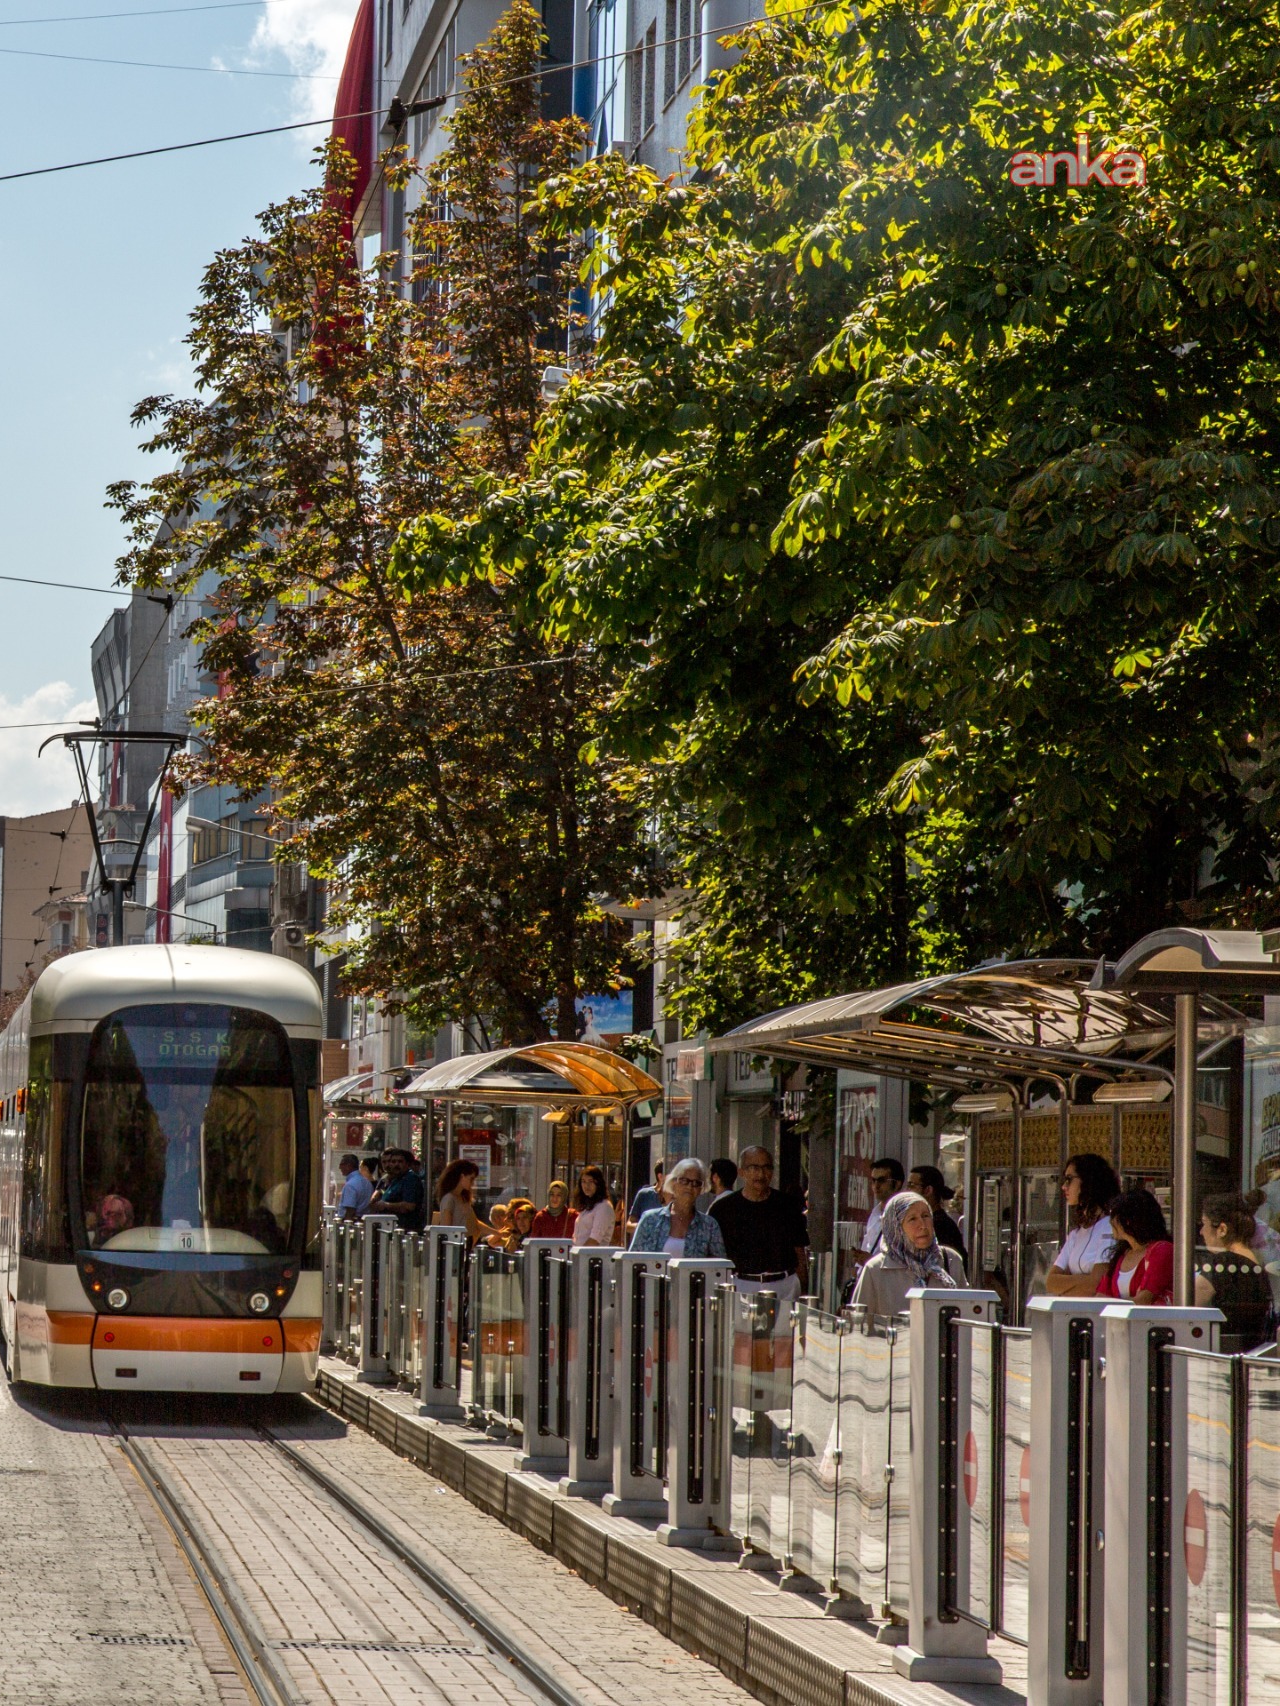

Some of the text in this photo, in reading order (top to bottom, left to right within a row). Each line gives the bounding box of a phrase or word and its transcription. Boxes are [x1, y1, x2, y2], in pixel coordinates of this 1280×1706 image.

[159, 1044, 231, 1057] OTOGAR
[733, 1051, 751, 1081] TEB
[844, 1091, 875, 1160] KPSS
[181, 1237, 192, 1248] 10
